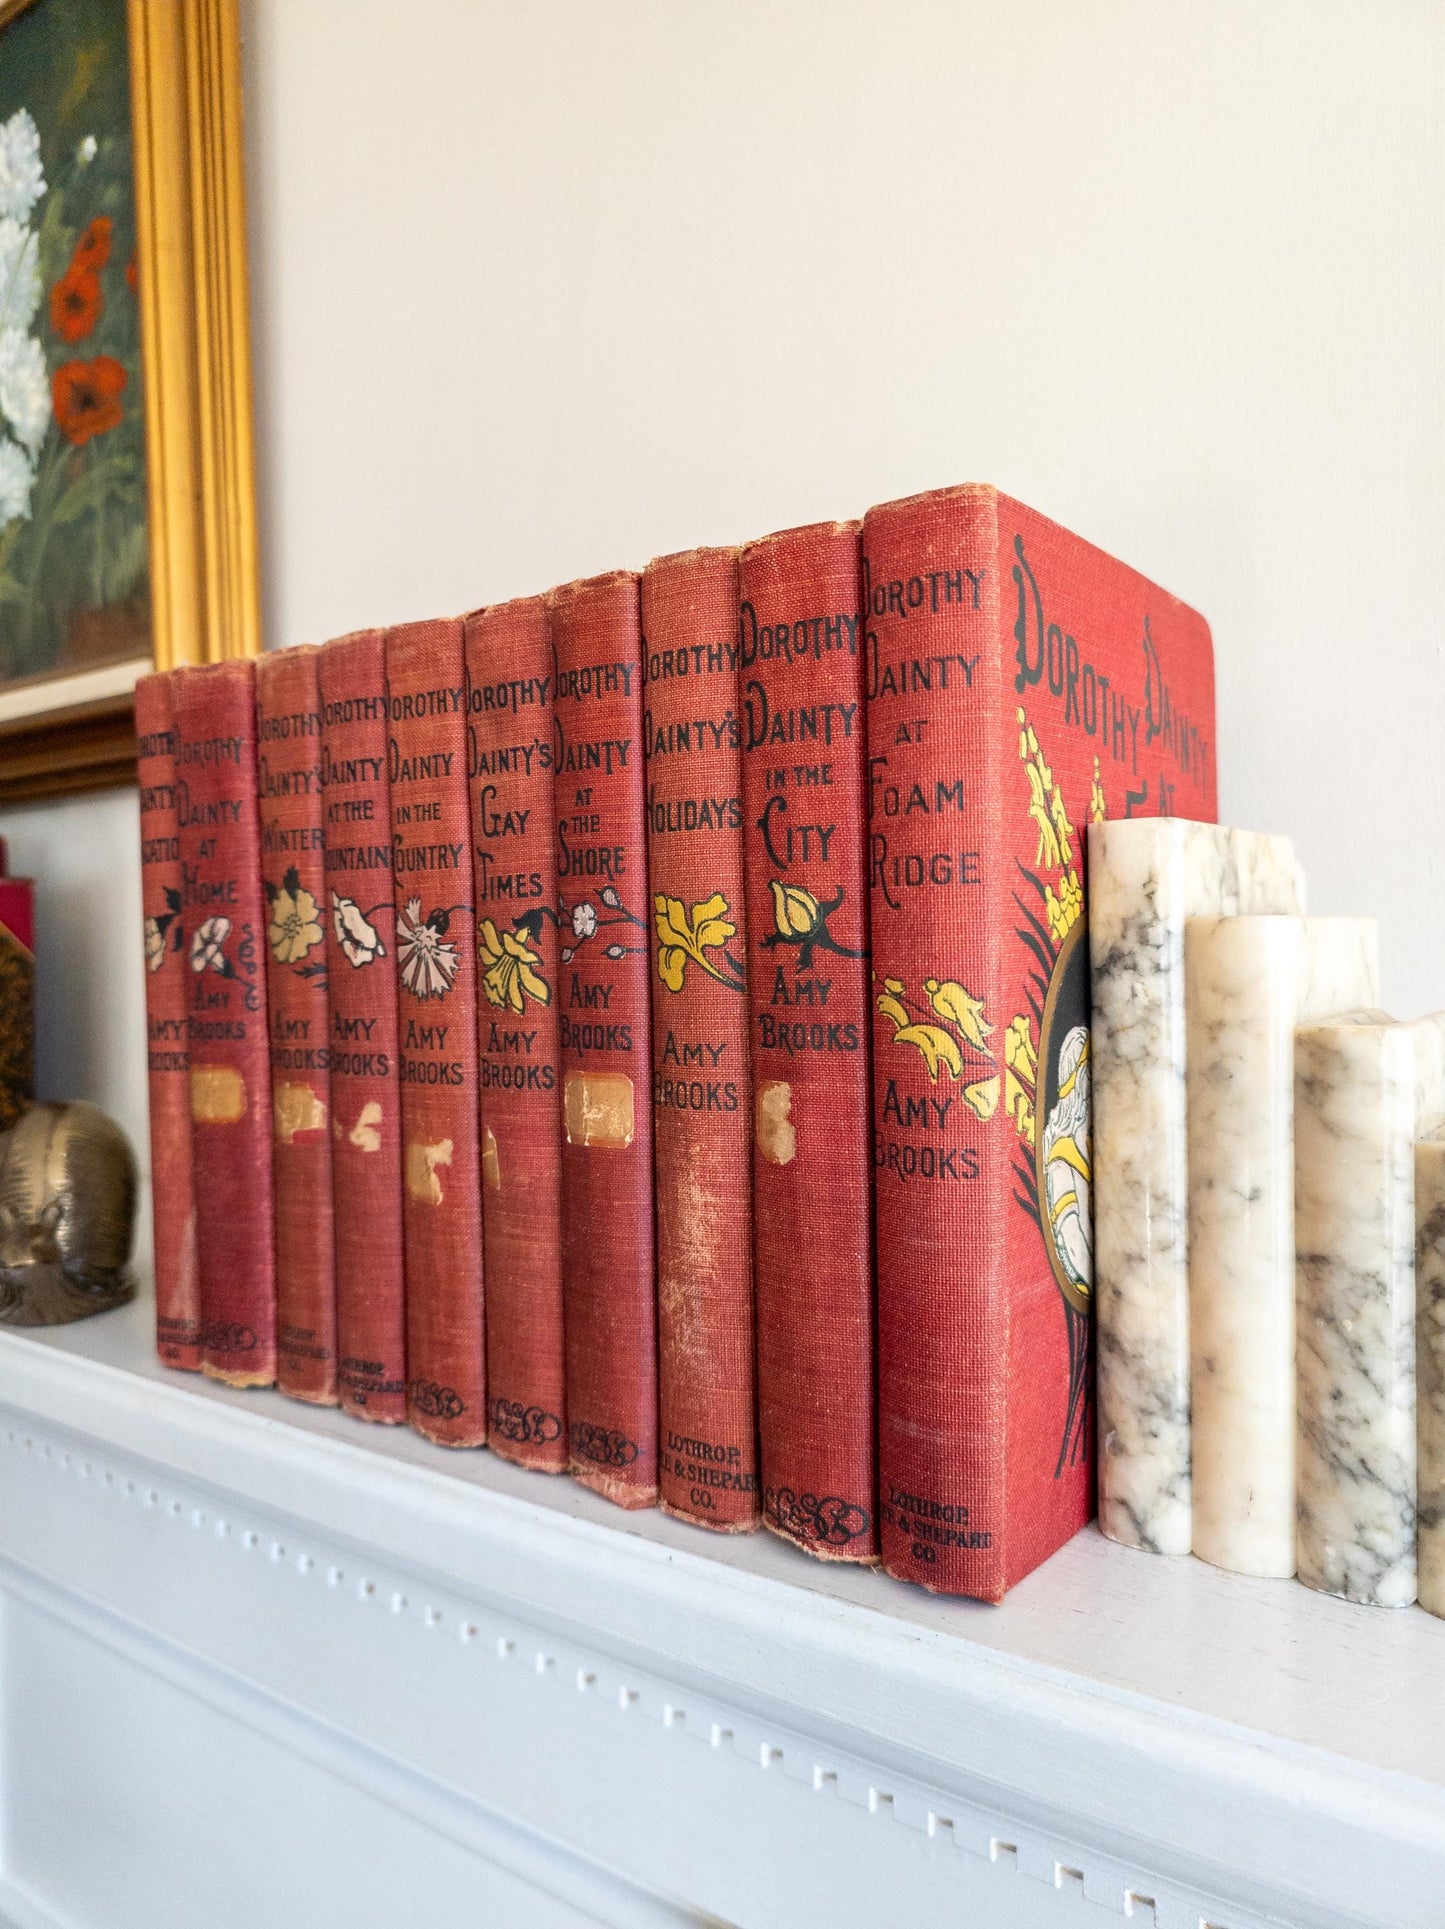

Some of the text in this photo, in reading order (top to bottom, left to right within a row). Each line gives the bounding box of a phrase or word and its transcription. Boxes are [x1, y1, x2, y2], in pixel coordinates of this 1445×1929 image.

[740, 601, 860, 674] DOROTHY
[866, 631, 982, 701] DAINTY
[1012, 533, 1208, 802] DOROTHY DAINTY
[745, 680, 858, 752] DAINTY
[894, 720, 928, 747] AT
[575, 788, 593, 807] AT
[766, 764, 833, 791] IN THE
[868, 756, 965, 821] FOAM
[343, 800, 374, 821] THE
[396, 802, 441, 825] IN THE
[481, 785, 531, 838] GAY
[572, 815, 600, 834] THE
[648, 784, 744, 835] OLIDAYS
[200, 838, 217, 859] AT
[558, 819, 626, 882] SHORE
[757, 795, 836, 872] CITY
[477, 846, 544, 901] TIMES
[870, 833, 982, 910] RIDGE
[569, 973, 613, 1009] AMY
[770, 965, 833, 1006] AMY
[334, 1012, 377, 1042] AMY
[405, 1018, 449, 1051] AMY
[488, 1022, 538, 1053] AMY
[558, 1015, 634, 1057] BROOKS
[757, 1013, 859, 1057] BROOKS
[663, 1031, 728, 1067] AMY
[400, 1054, 465, 1086] BROOKS
[480, 1058, 555, 1090] BROOKS
[654, 1070, 741, 1113] BROOKS
[881, 1079, 951, 1129] AMY
[875, 1131, 980, 1182] BROOKS
[686, 1463, 759, 1492] SHEPAR
